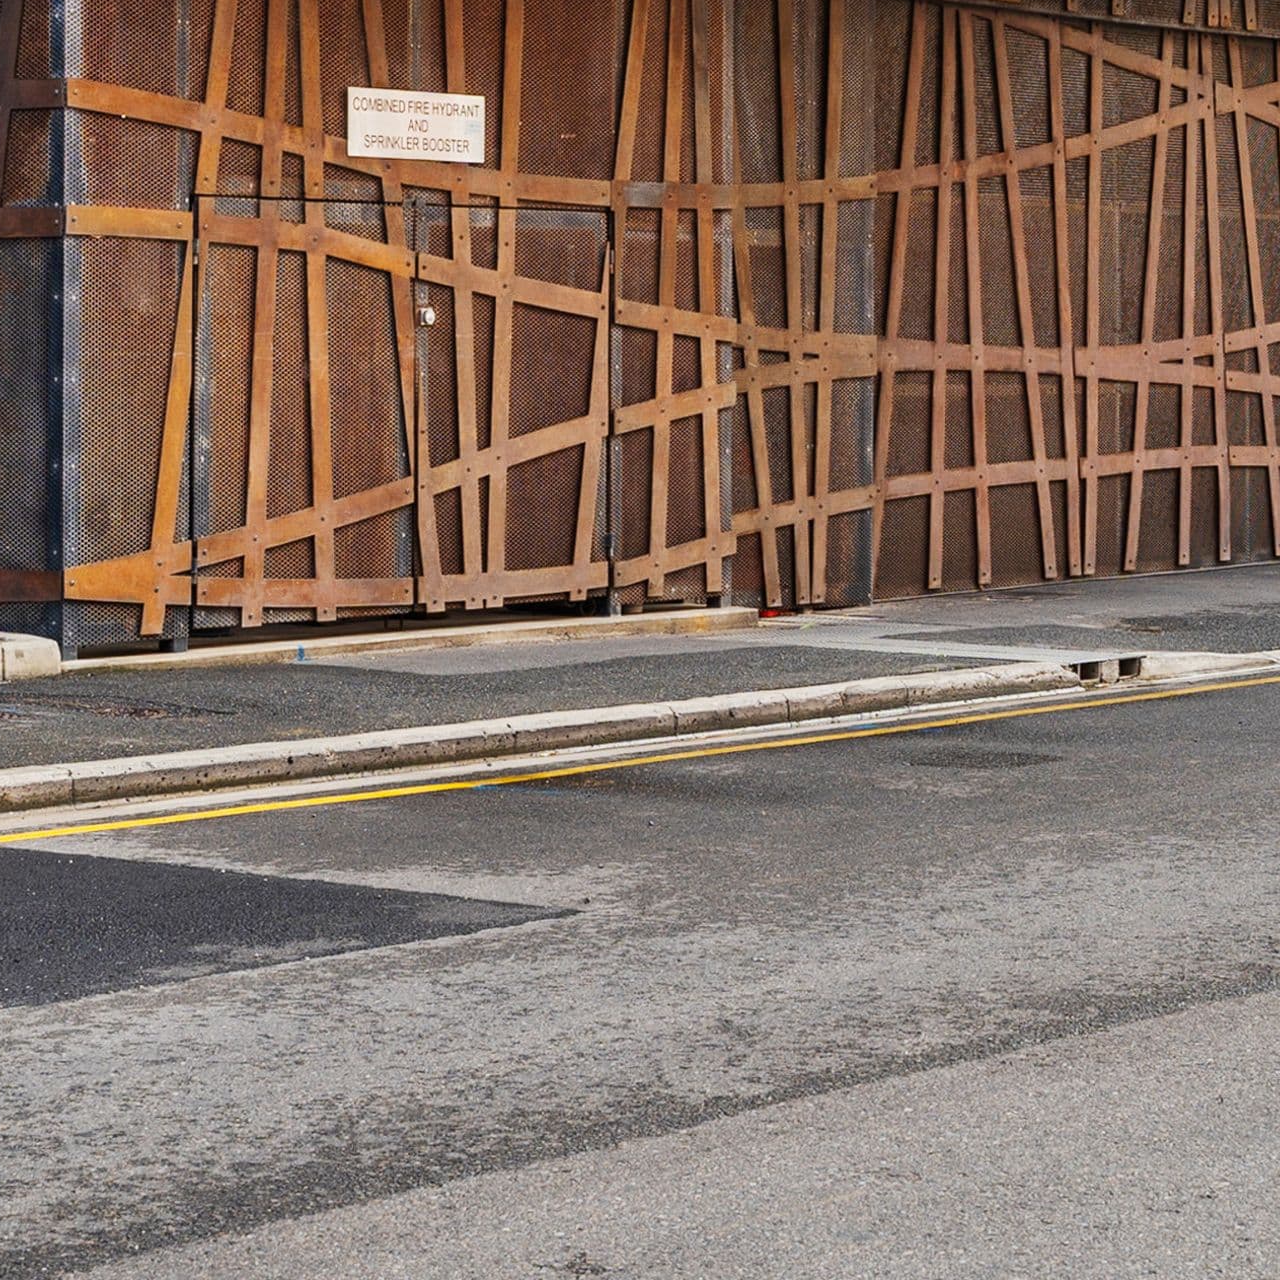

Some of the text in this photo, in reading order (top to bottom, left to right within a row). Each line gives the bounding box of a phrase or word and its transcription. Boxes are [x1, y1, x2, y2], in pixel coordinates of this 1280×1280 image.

[352, 96, 480, 117] COMBINED FIRE HYDRANT
[408, 119, 428, 133] AND
[364, 134, 470, 153] SPRINKLER BOOSTER
